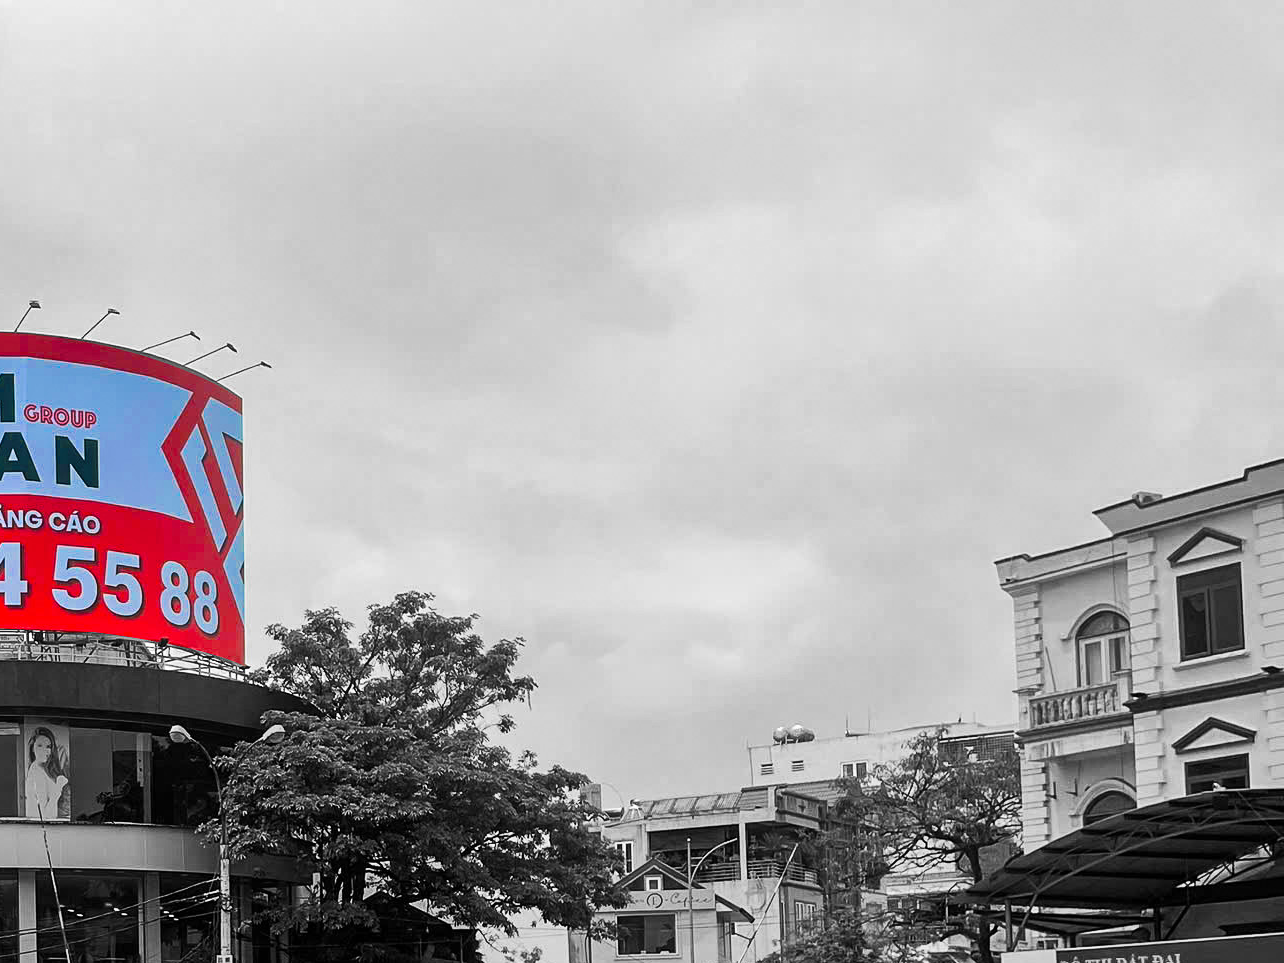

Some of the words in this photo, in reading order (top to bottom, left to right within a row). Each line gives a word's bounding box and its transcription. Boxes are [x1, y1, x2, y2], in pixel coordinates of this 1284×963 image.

[23, 403, 97, 429] GROUP
[48, 510, 101, 534] CÁO
[51, 544, 143, 617] 55
[159, 560, 220, 635] 88
